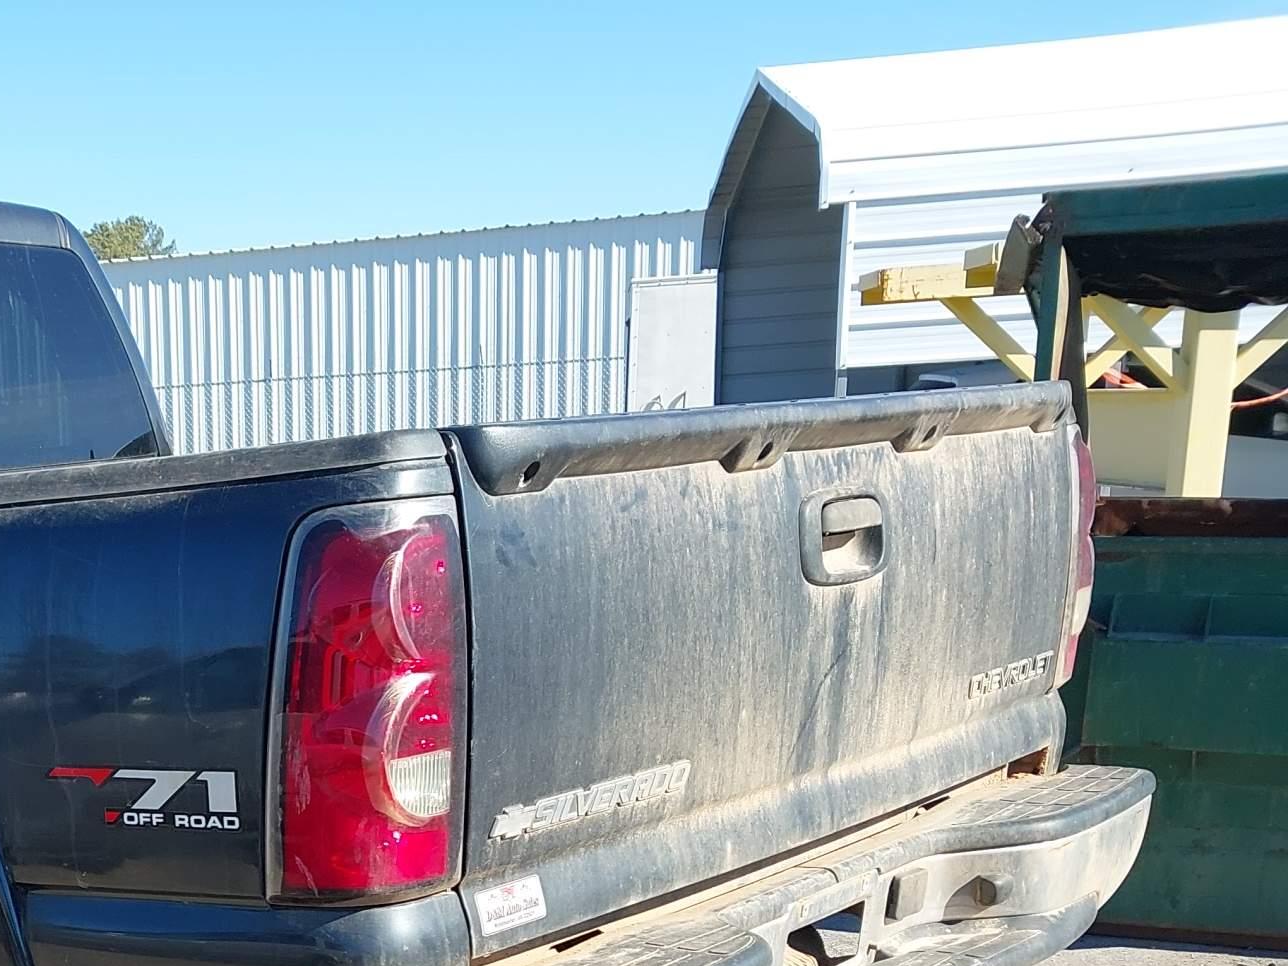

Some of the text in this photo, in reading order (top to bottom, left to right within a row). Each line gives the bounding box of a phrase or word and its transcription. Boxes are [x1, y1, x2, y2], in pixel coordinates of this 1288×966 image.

[968, 649, 1054, 700] CHEVROLET
[123, 812, 240, 829] OFF ROAD
[528, 760, 691, 832] SILVERADO
